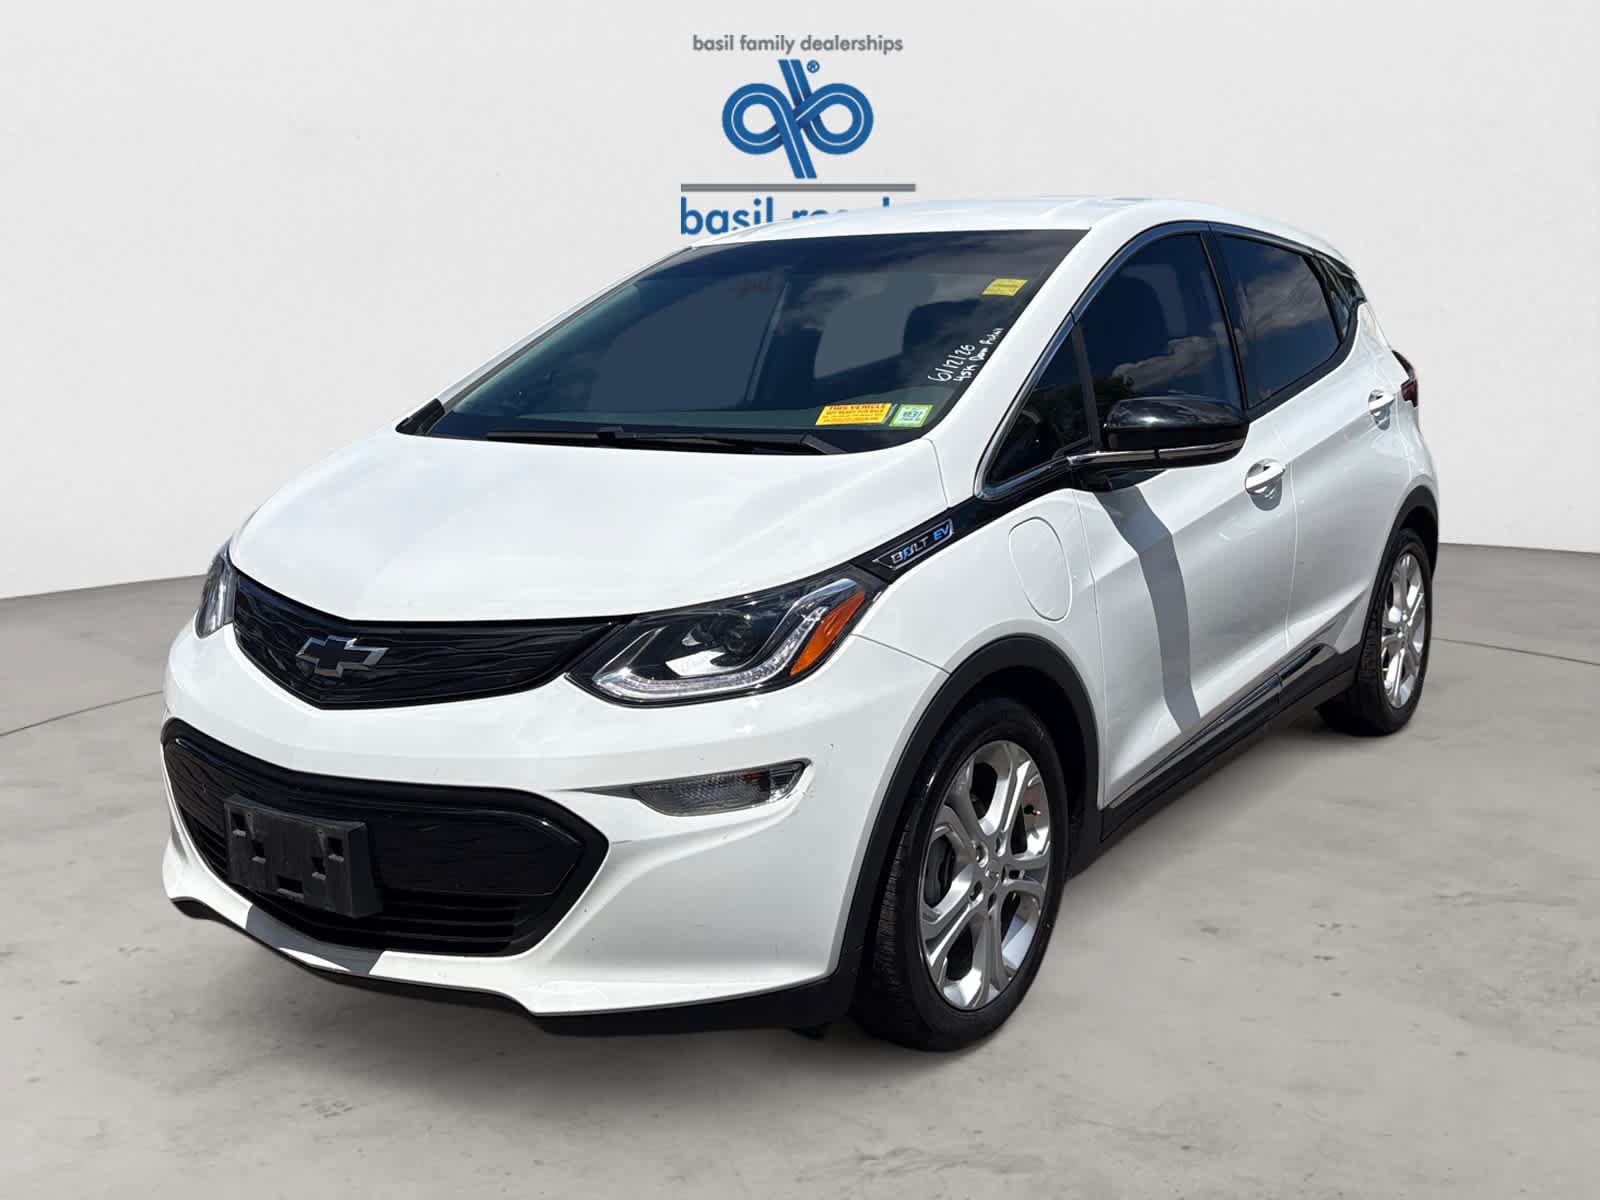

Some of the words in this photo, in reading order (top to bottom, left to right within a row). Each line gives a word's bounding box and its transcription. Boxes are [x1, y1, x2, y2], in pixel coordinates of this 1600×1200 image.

[692, 34, 734, 51] basil
[739, 34, 795, 55] family
[800, 34, 904, 55] dealerships
[680, 196, 774, 235] basil
[891, 536, 929, 564] BOLT
[933, 524, 950, 541] EV
